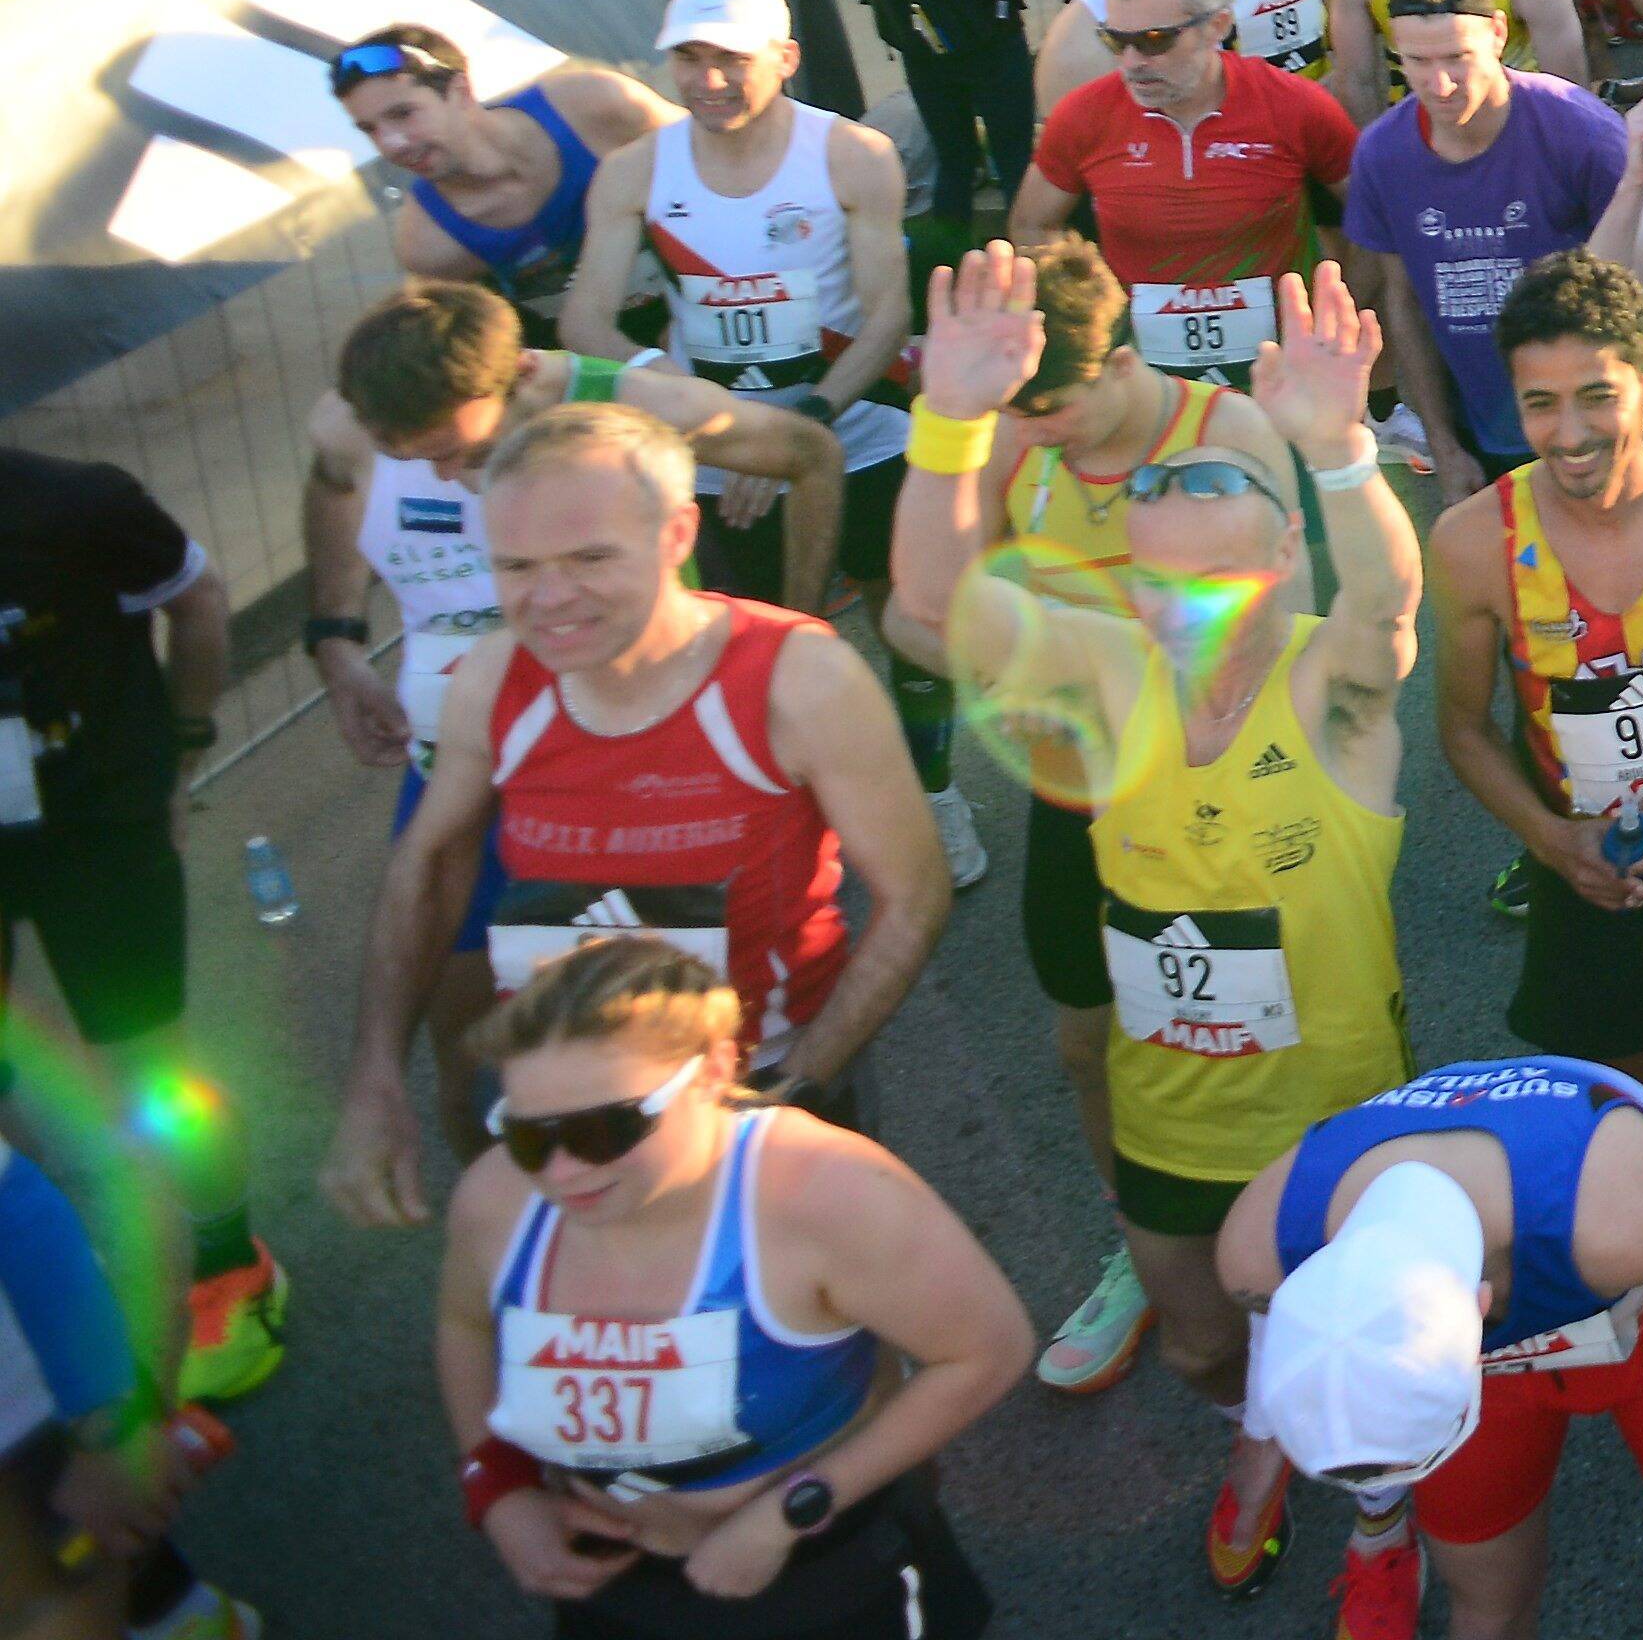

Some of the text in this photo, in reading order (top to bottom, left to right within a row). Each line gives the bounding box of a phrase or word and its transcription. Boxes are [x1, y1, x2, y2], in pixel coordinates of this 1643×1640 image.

[1173, 288, 1243, 311] MAIF
[715, 309, 769, 347] 101
[1183, 314, 1225, 350] 85
[1156, 951, 1217, 1001] 92
[1161, 1023, 1253, 1052] MAIF
[1488, 1078, 1580, 1103] SUD
[555, 1317, 674, 1364] MAIF
[555, 1375, 653, 1443] 337
